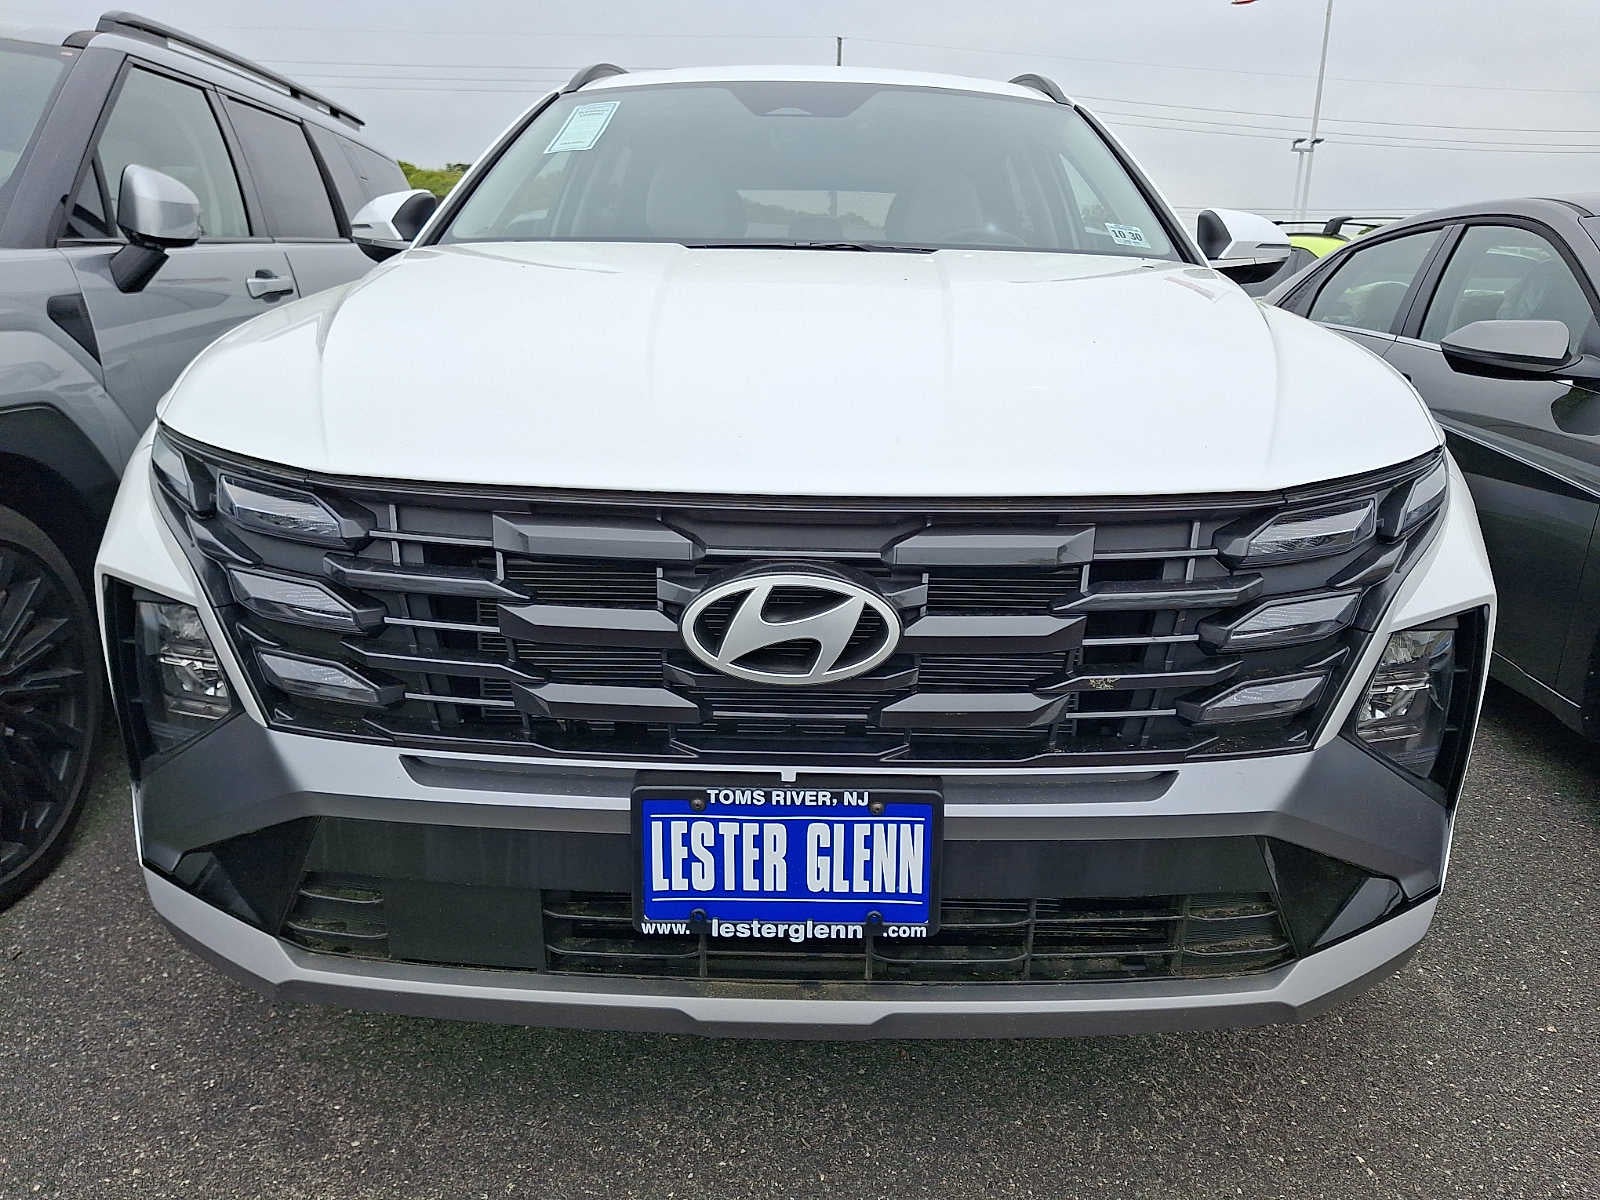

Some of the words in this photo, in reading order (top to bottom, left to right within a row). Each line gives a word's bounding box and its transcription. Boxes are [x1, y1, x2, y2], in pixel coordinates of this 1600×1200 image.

[1112, 230, 1127, 239] 10
[1129, 232, 1142, 241] 30
[706, 789, 766, 805] TOMS
[771, 790, 838, 807] RIVER,
[843, 791, 869, 807] NJ
[650, 820, 788, 892] LESTER
[806, 822, 924, 895] GLENN
[640, 921, 691, 935] www.
[711, 919, 863, 943] lesterglenn
[882, 924, 927, 938] .com
